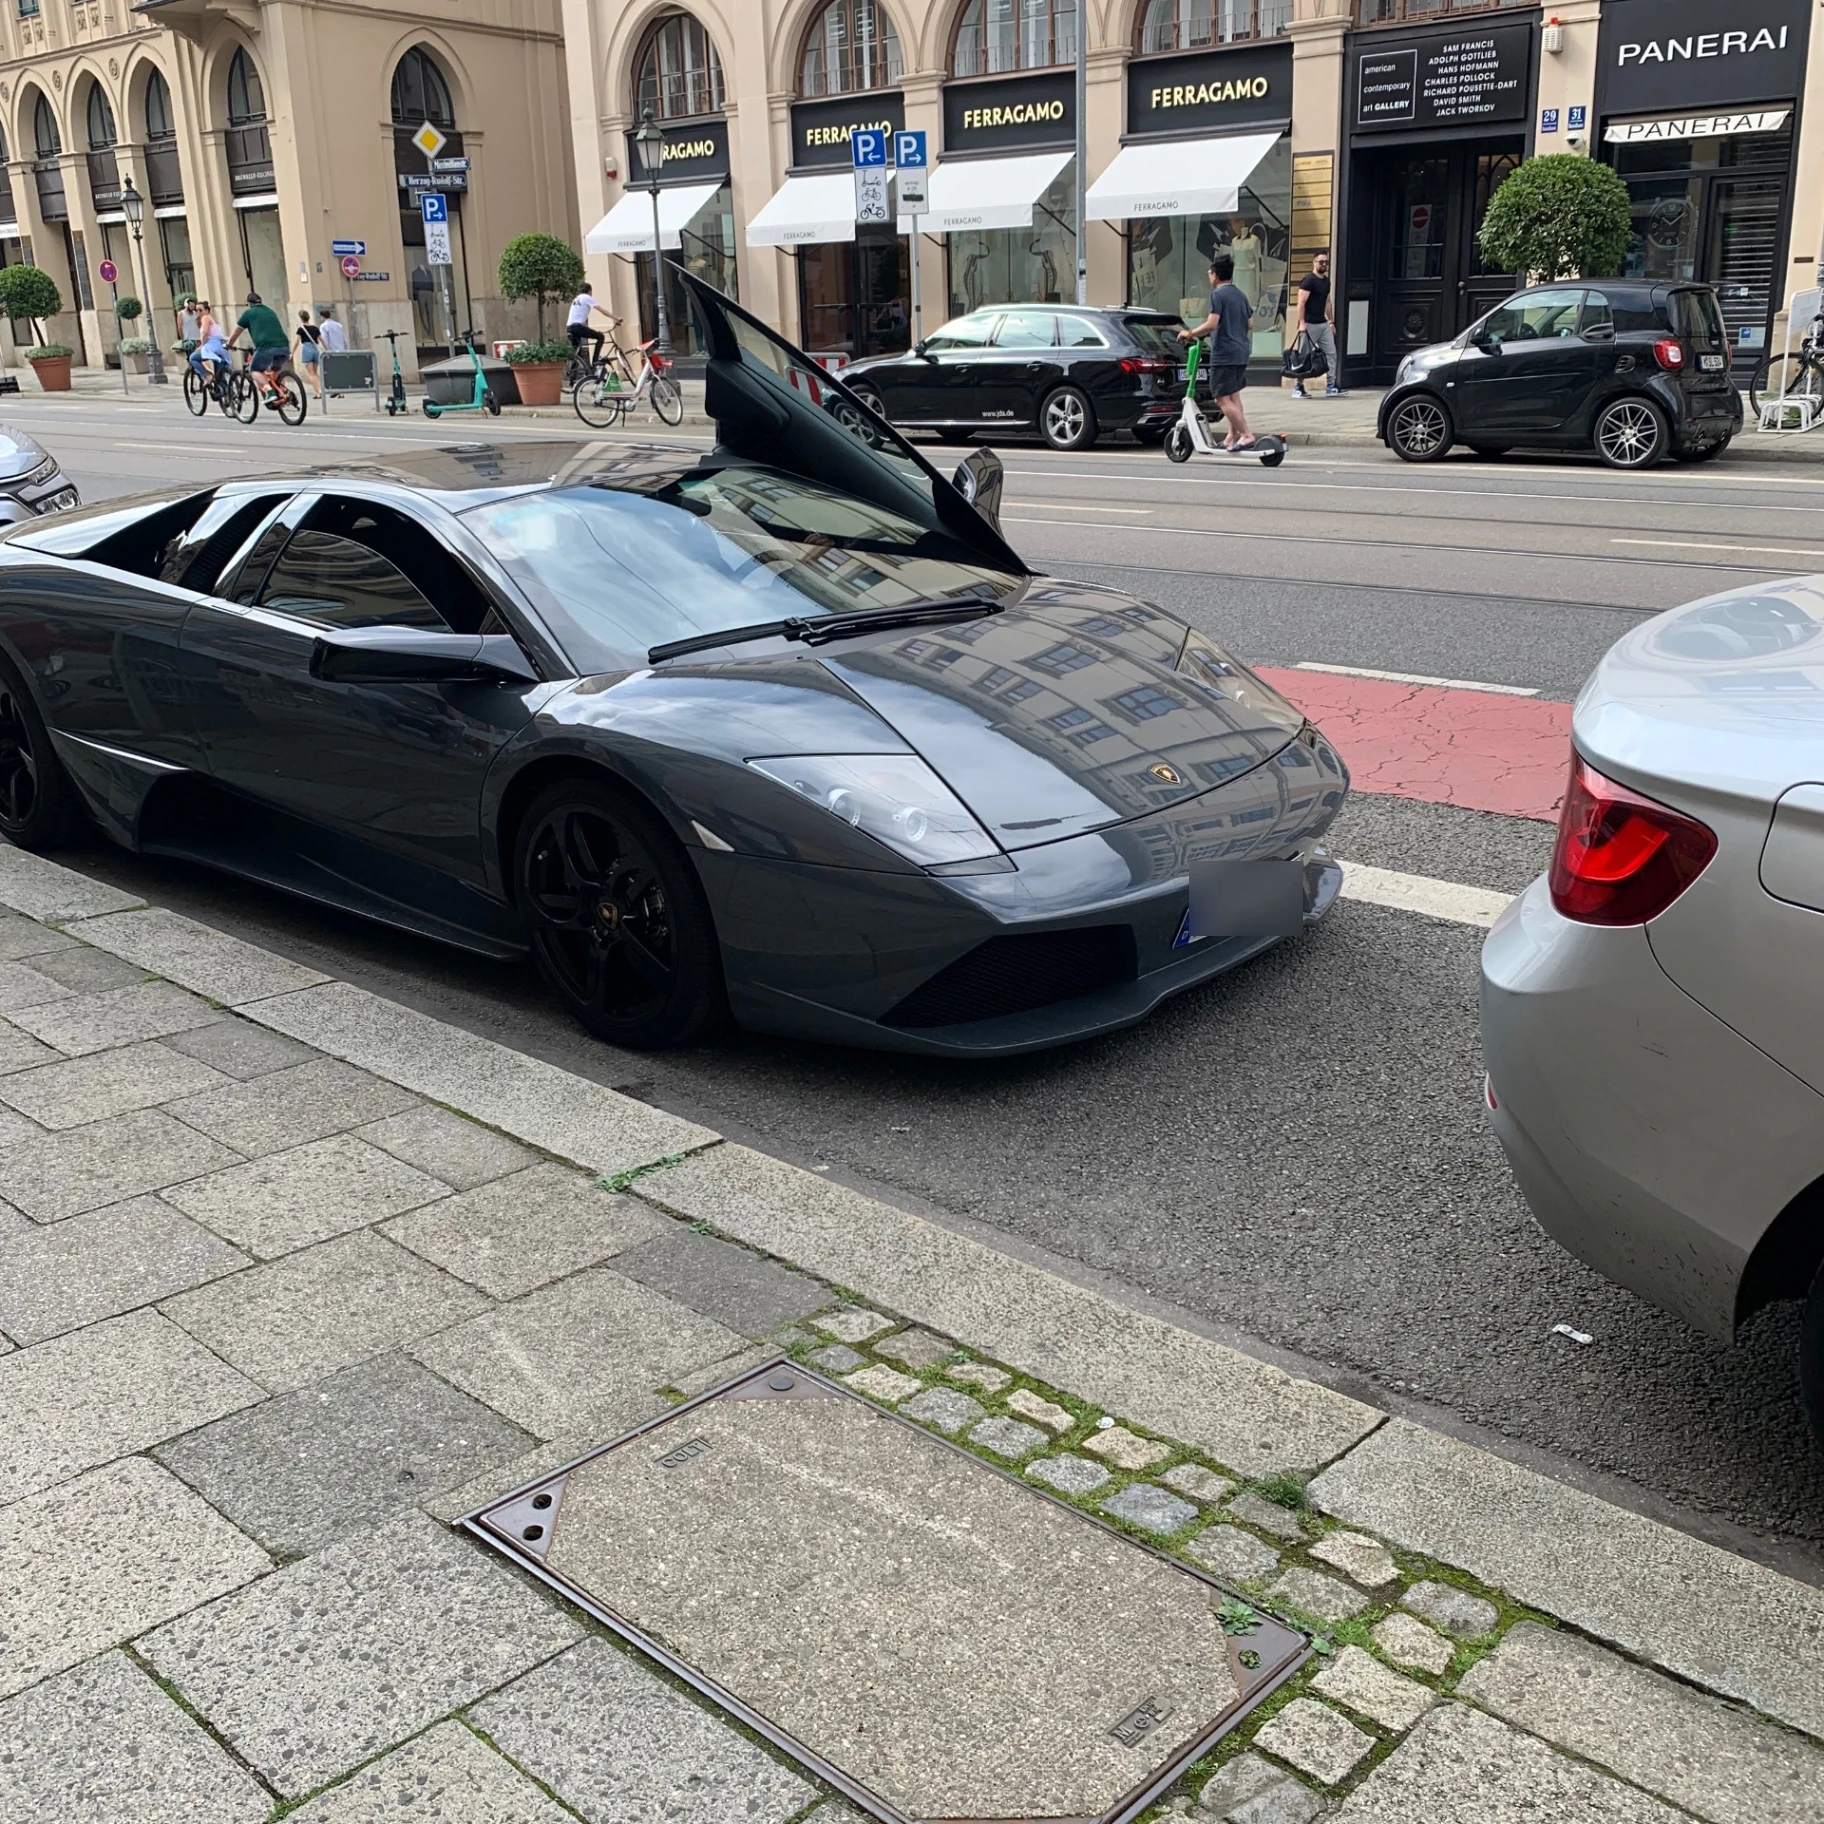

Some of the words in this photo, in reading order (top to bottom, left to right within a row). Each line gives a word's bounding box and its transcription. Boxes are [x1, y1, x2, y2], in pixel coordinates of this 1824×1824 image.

[1443, 44, 1459, 53] SAM
[1461, 40, 1494, 50] FRANCIS
[1618, 25, 1788, 66] PANERAI
[1428, 55, 1459, 65] ADOLPH
[1461, 50, 1496, 61] GOTTLIEB
[1364, 64, 1396, 74] american
[1438, 65, 1458, 74] HANS
[1460, 61, 1499, 72] HOFMANN
[1425, 76, 1457, 87] CHARLES
[1459, 72, 1495, 83] POLLOCK
[1152, 77, 1268, 109] FERRAGAMO
[1363, 82, 1411, 93] contemporary
[1423, 86, 1457, 97] RICHARD
[1459, 80, 1518, 93] POUSETTE-DART
[1363, 104, 1373, 112] art
[1374, 100, 1410, 111] GALLERY
[1433, 97, 1456, 106] DAVID
[1458, 94, 1481, 104] SMITH
[964, 100, 1064, 129] FERRAGAMO
[1436, 107, 1456, 117] JACK
[1458, 103, 1495, 114] TWORKOV
[1543, 110, 1557, 122] 29
[1571, 107, 1582, 120] 31
[806, 120, 892, 146] FERRAO
[1627, 113, 1764, 140] PANERAI
[662, 139, 714, 160] RAGAMO
[857, 134, 876, 163] P
[900, 136, 917, 164] P
[408, 176, 464, 186] Herzog-Rudolf-Str.
[425, 198, 438, 220] P
[1134, 201, 1179, 212] FERRAGAMO
[944, 216, 982, 226] FERRAGAMO
[783, 231, 815, 240] FERRAGAMO
[618, 240, 646, 248] FERRAGAMO
[982, 410, 1014, 418] www.jda.de
[662, 1444, 704, 1468] COLT
